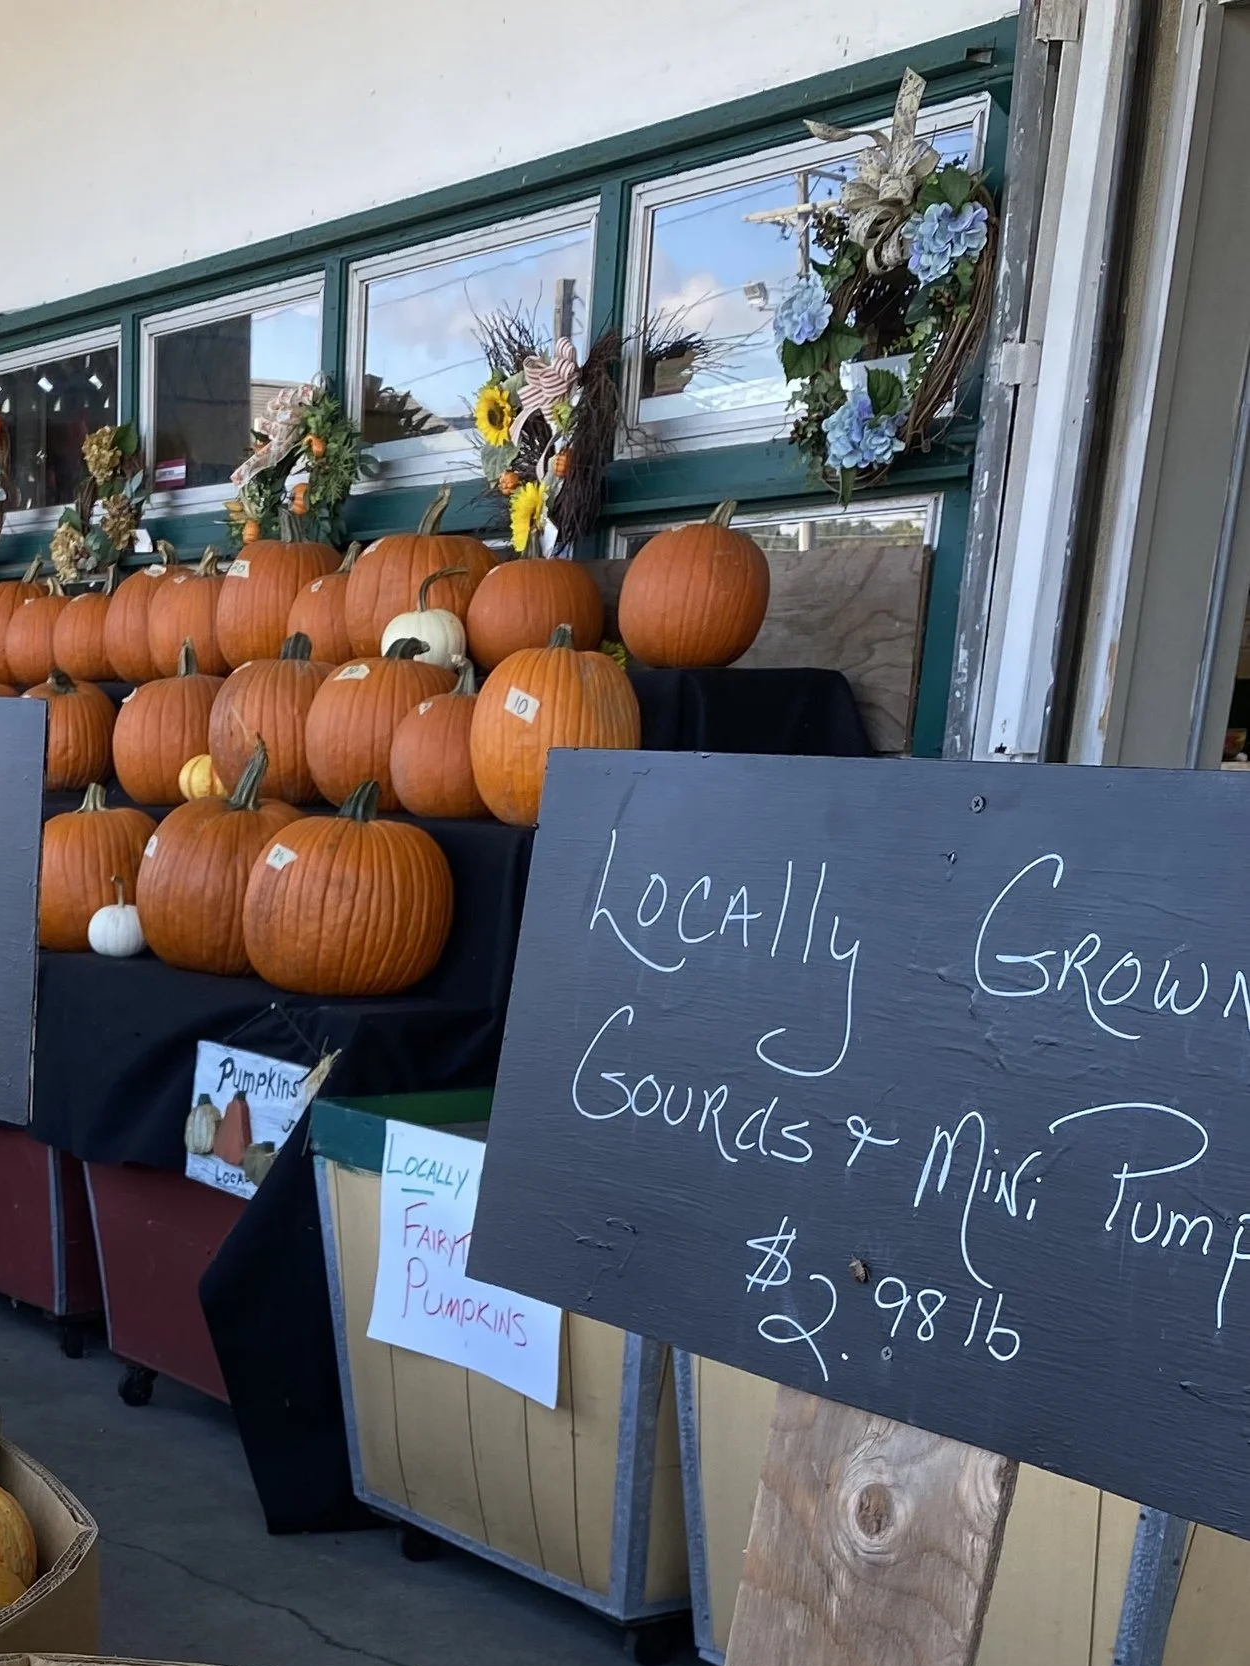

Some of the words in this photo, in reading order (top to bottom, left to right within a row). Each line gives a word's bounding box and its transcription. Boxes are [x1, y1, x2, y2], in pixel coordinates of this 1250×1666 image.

[514, 695, 528, 715] 10
[386, 1132, 470, 1200] LOCALLY
[401, 1256, 528, 1348] PUMPKINS
[964, 1293, 1021, 1361] lb
